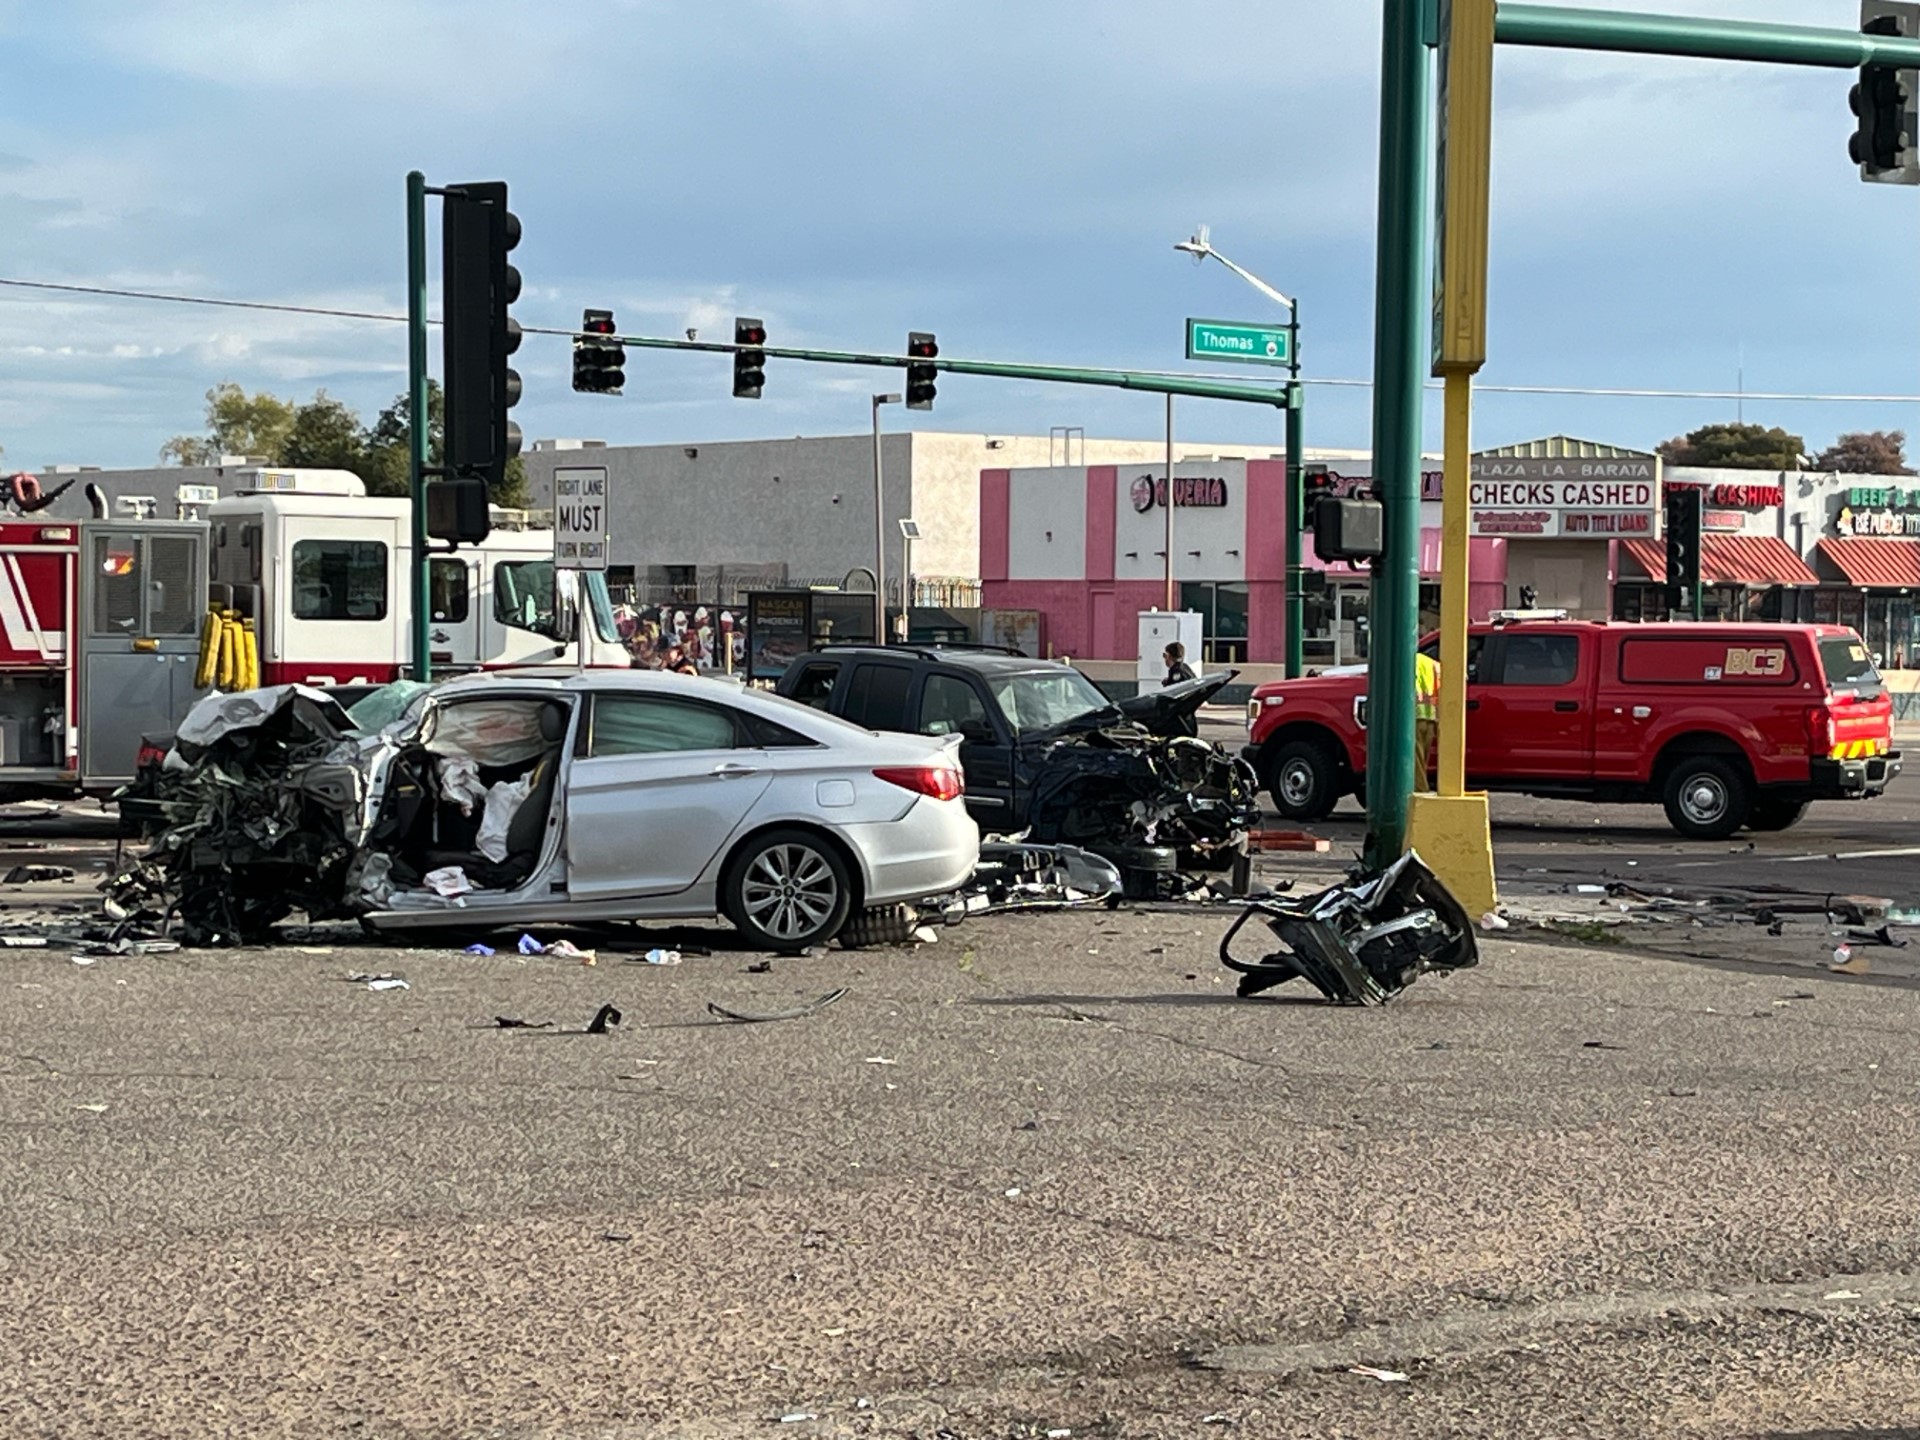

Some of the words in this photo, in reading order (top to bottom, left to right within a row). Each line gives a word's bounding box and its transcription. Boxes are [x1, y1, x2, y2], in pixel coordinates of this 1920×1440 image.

[1202, 331, 1254, 351] Thomas
[1471, 464, 1526, 476] PLAZA
[1542, 464, 1566, 476] LA
[1581, 464, 1650, 477] BARATA
[557, 479, 580, 496] RIGHT
[582, 479, 604, 496] LANE
[1155, 478, 1222, 506] NVERIA
[1470, 483, 1555, 505] CHECKS
[1562, 483, 1650, 506] CASHED
[1714, 484, 1784, 508] CASHING
[1850, 487, 1889, 507] BEER
[559, 504, 602, 533] MUST
[1565, 514, 1590, 532] AUTO
[1592, 514, 1616, 532] TITLE
[1618, 513, 1650, 532] LOANS
[557, 541, 578, 559] TURN
[580, 541, 603, 559] RIGHT
[1724, 648, 1786, 675] BC3
